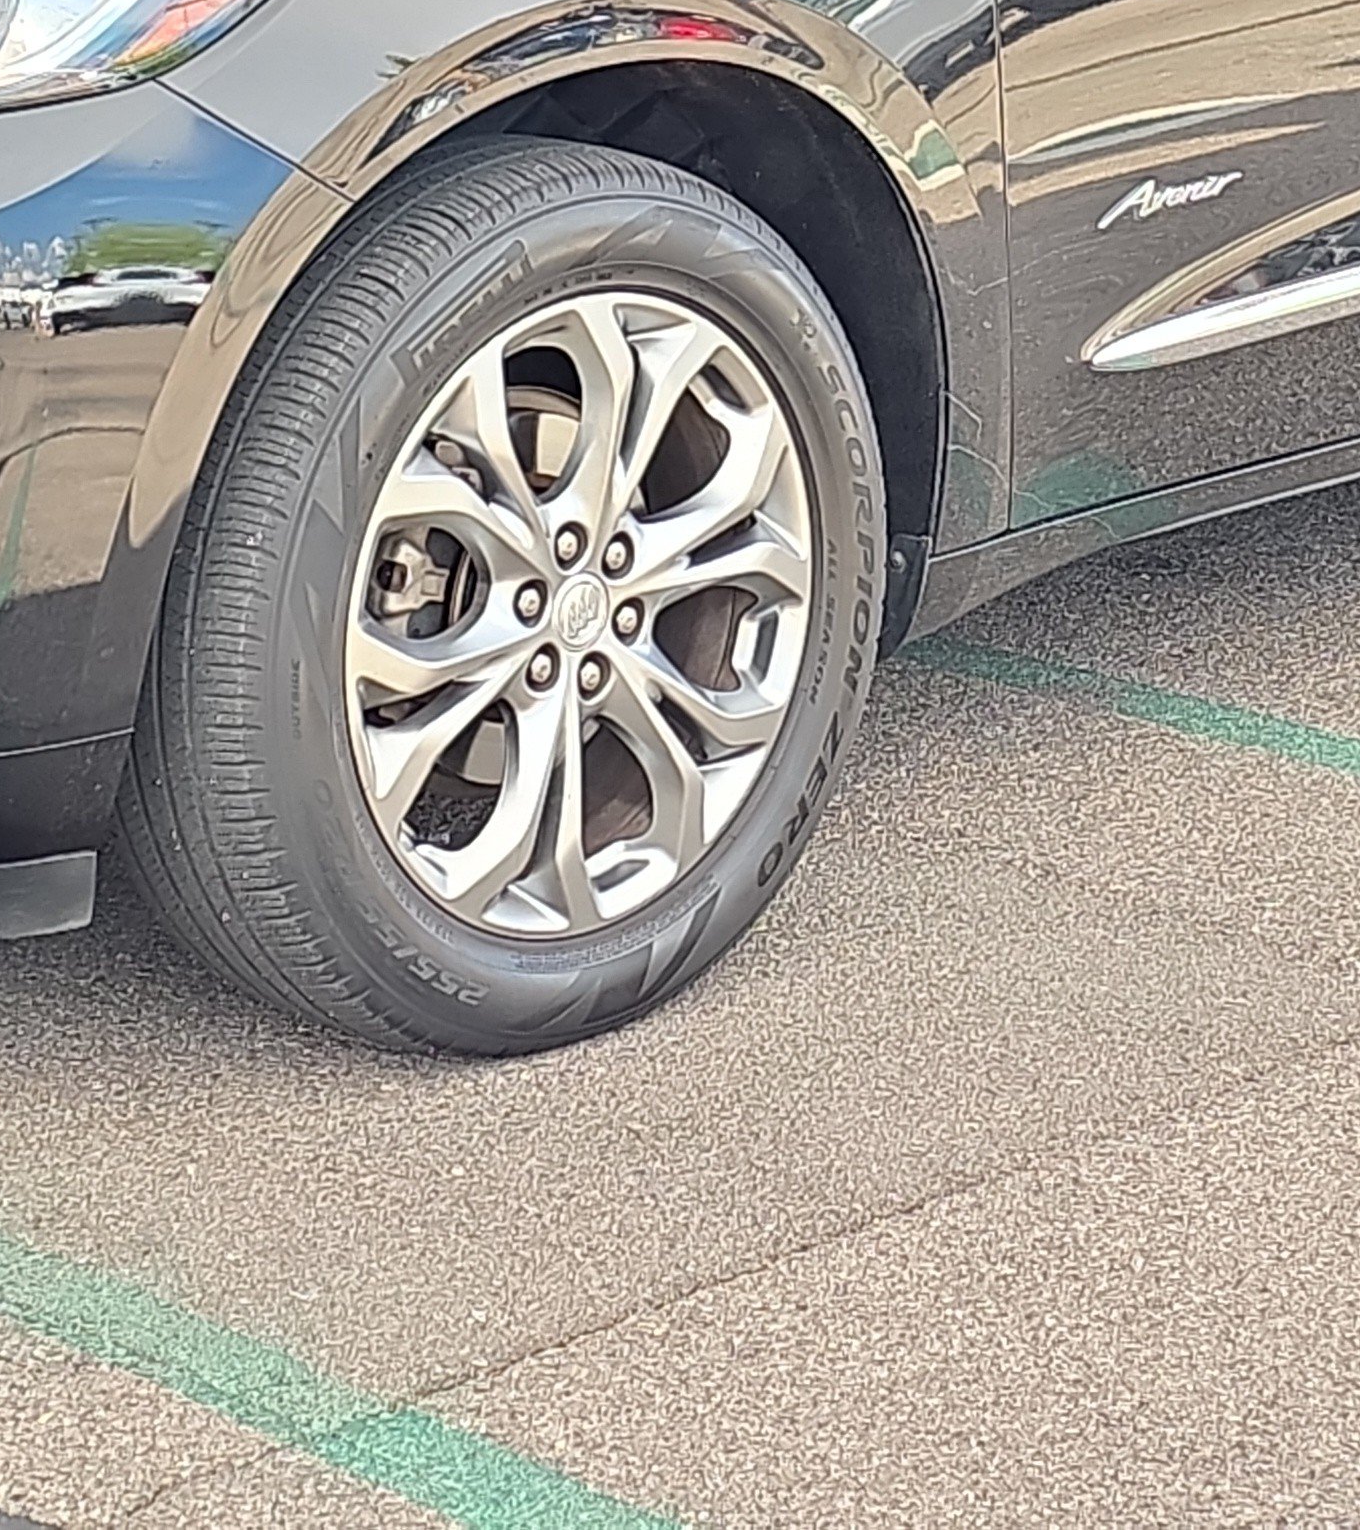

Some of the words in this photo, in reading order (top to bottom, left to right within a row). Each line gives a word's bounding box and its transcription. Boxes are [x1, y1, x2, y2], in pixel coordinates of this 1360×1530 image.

[1096, 171, 1243, 230] Avenir
[817, 363, 876, 695] SCORPION
[824, 536, 839, 582] ALL
[809, 592, 838, 705] SEASON
[757, 710, 843, 888] ZERO
